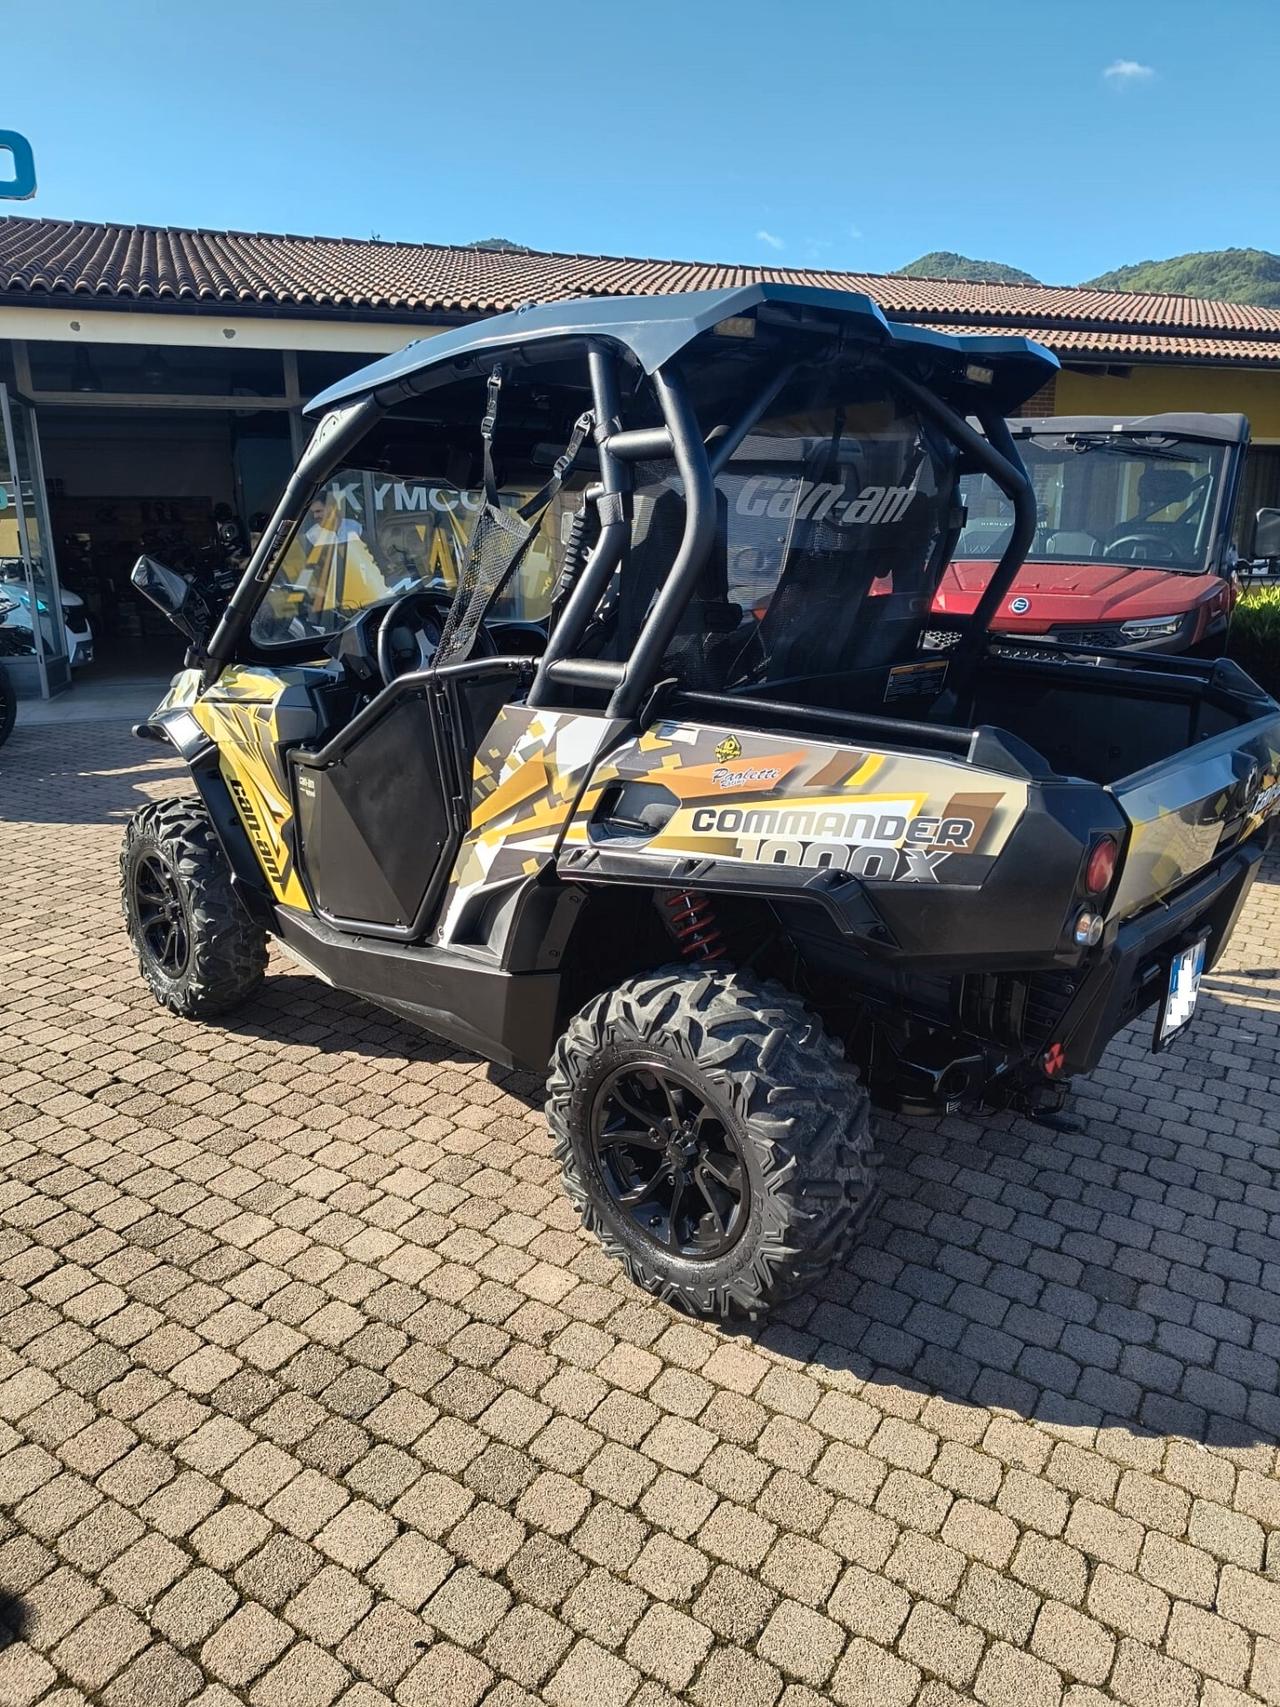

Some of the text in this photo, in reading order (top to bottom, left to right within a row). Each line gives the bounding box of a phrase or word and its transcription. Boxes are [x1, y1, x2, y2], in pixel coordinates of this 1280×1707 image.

[736, 474, 917, 524] can-am
[230, 779, 283, 883] can-am
[691, 808, 976, 848] COMMANDER
